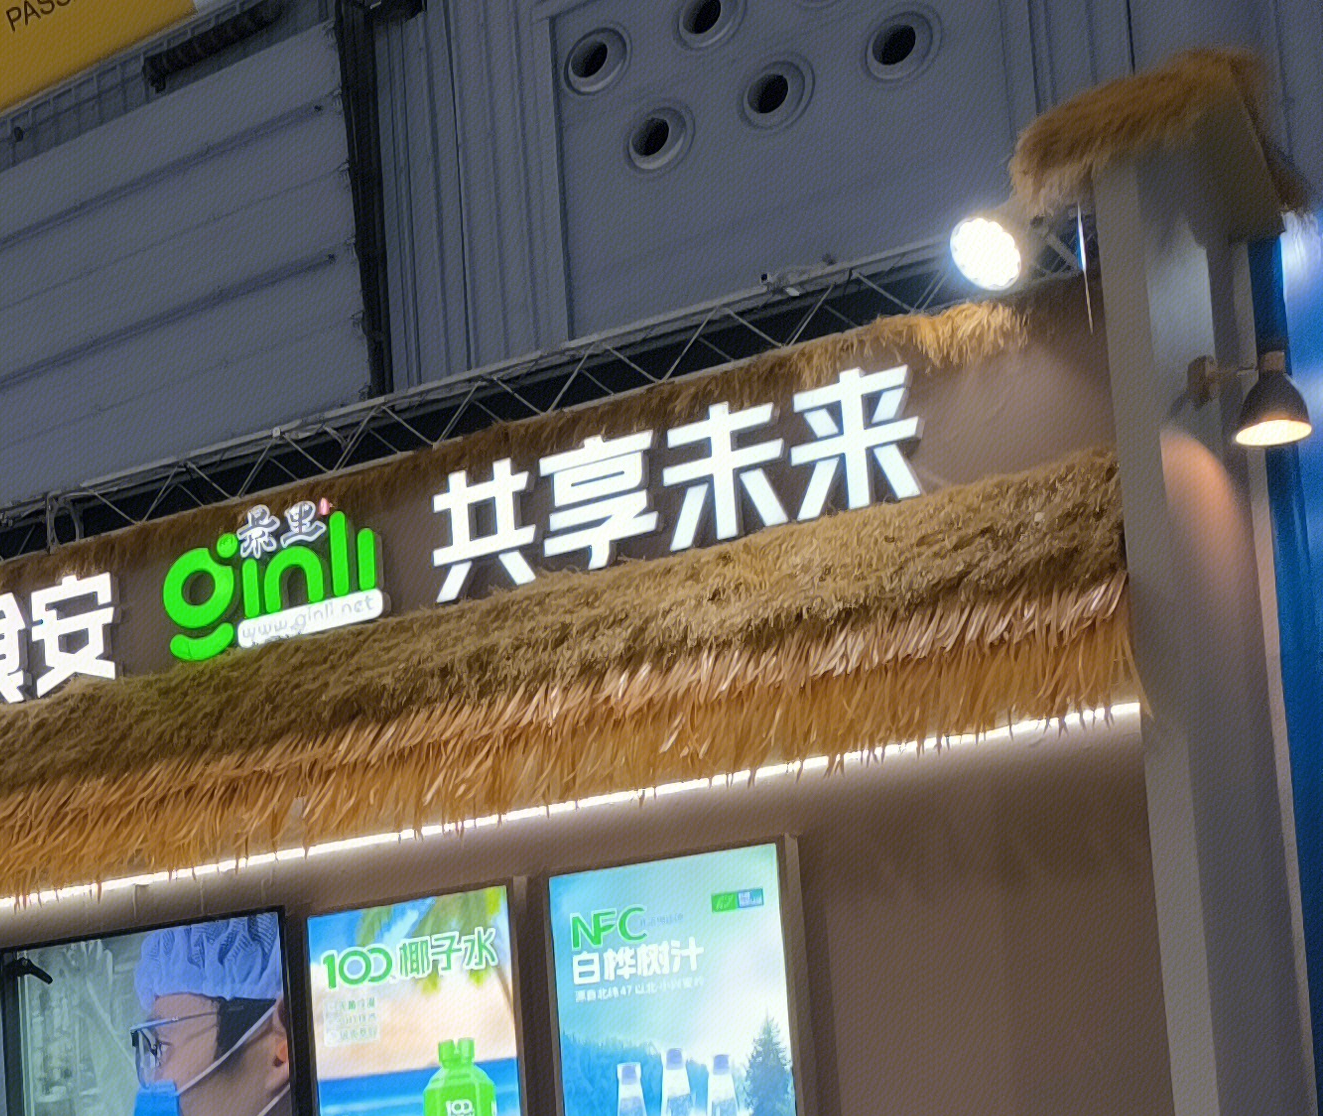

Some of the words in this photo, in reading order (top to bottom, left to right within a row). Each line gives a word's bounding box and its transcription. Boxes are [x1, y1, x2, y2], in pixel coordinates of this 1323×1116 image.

[6, 0, 77, 32] PAS
[432, 365, 922, 602] 共享未来
[570, 904, 648, 950] NFC
[572, 937, 705, 985] 白桦树汁
